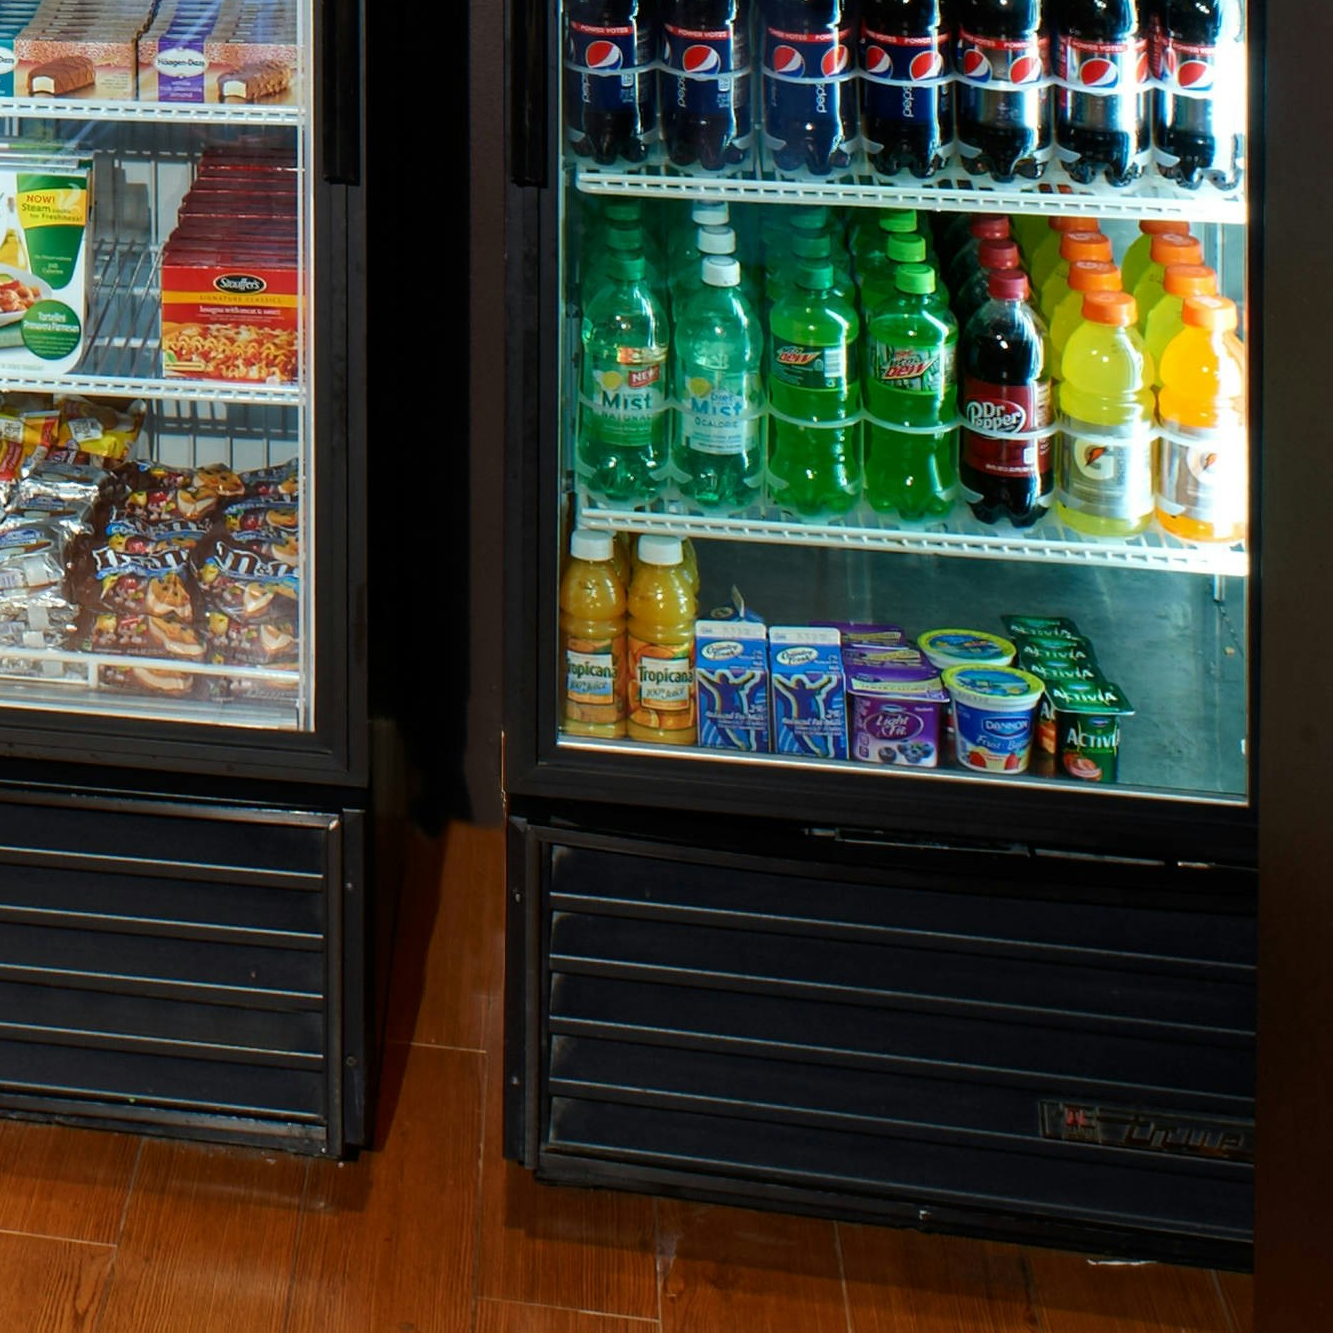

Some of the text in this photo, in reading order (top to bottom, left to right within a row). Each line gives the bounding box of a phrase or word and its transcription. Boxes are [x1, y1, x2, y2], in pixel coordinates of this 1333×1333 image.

[580, 25, 605, 34] POWER
[677, 28, 728, 38] POWER VOTES
[1071, 41, 1097, 51] POWER
[26, 194, 55, 204] NOW!
[22, 202, 51, 213] Steam
[219, 275, 262, 292] Stouffer's
[633, 369, 655, 382] NEW
[601, 390, 652, 411] Mist
[691, 397, 743, 417] Mist
[983, 401, 1005, 418] Dr
[967, 402, 1022, 433] Pepper
[637, 665, 694, 684] Tropicana
[875, 715, 909, 730] Light
[985, 719, 1029, 733] DANNON
